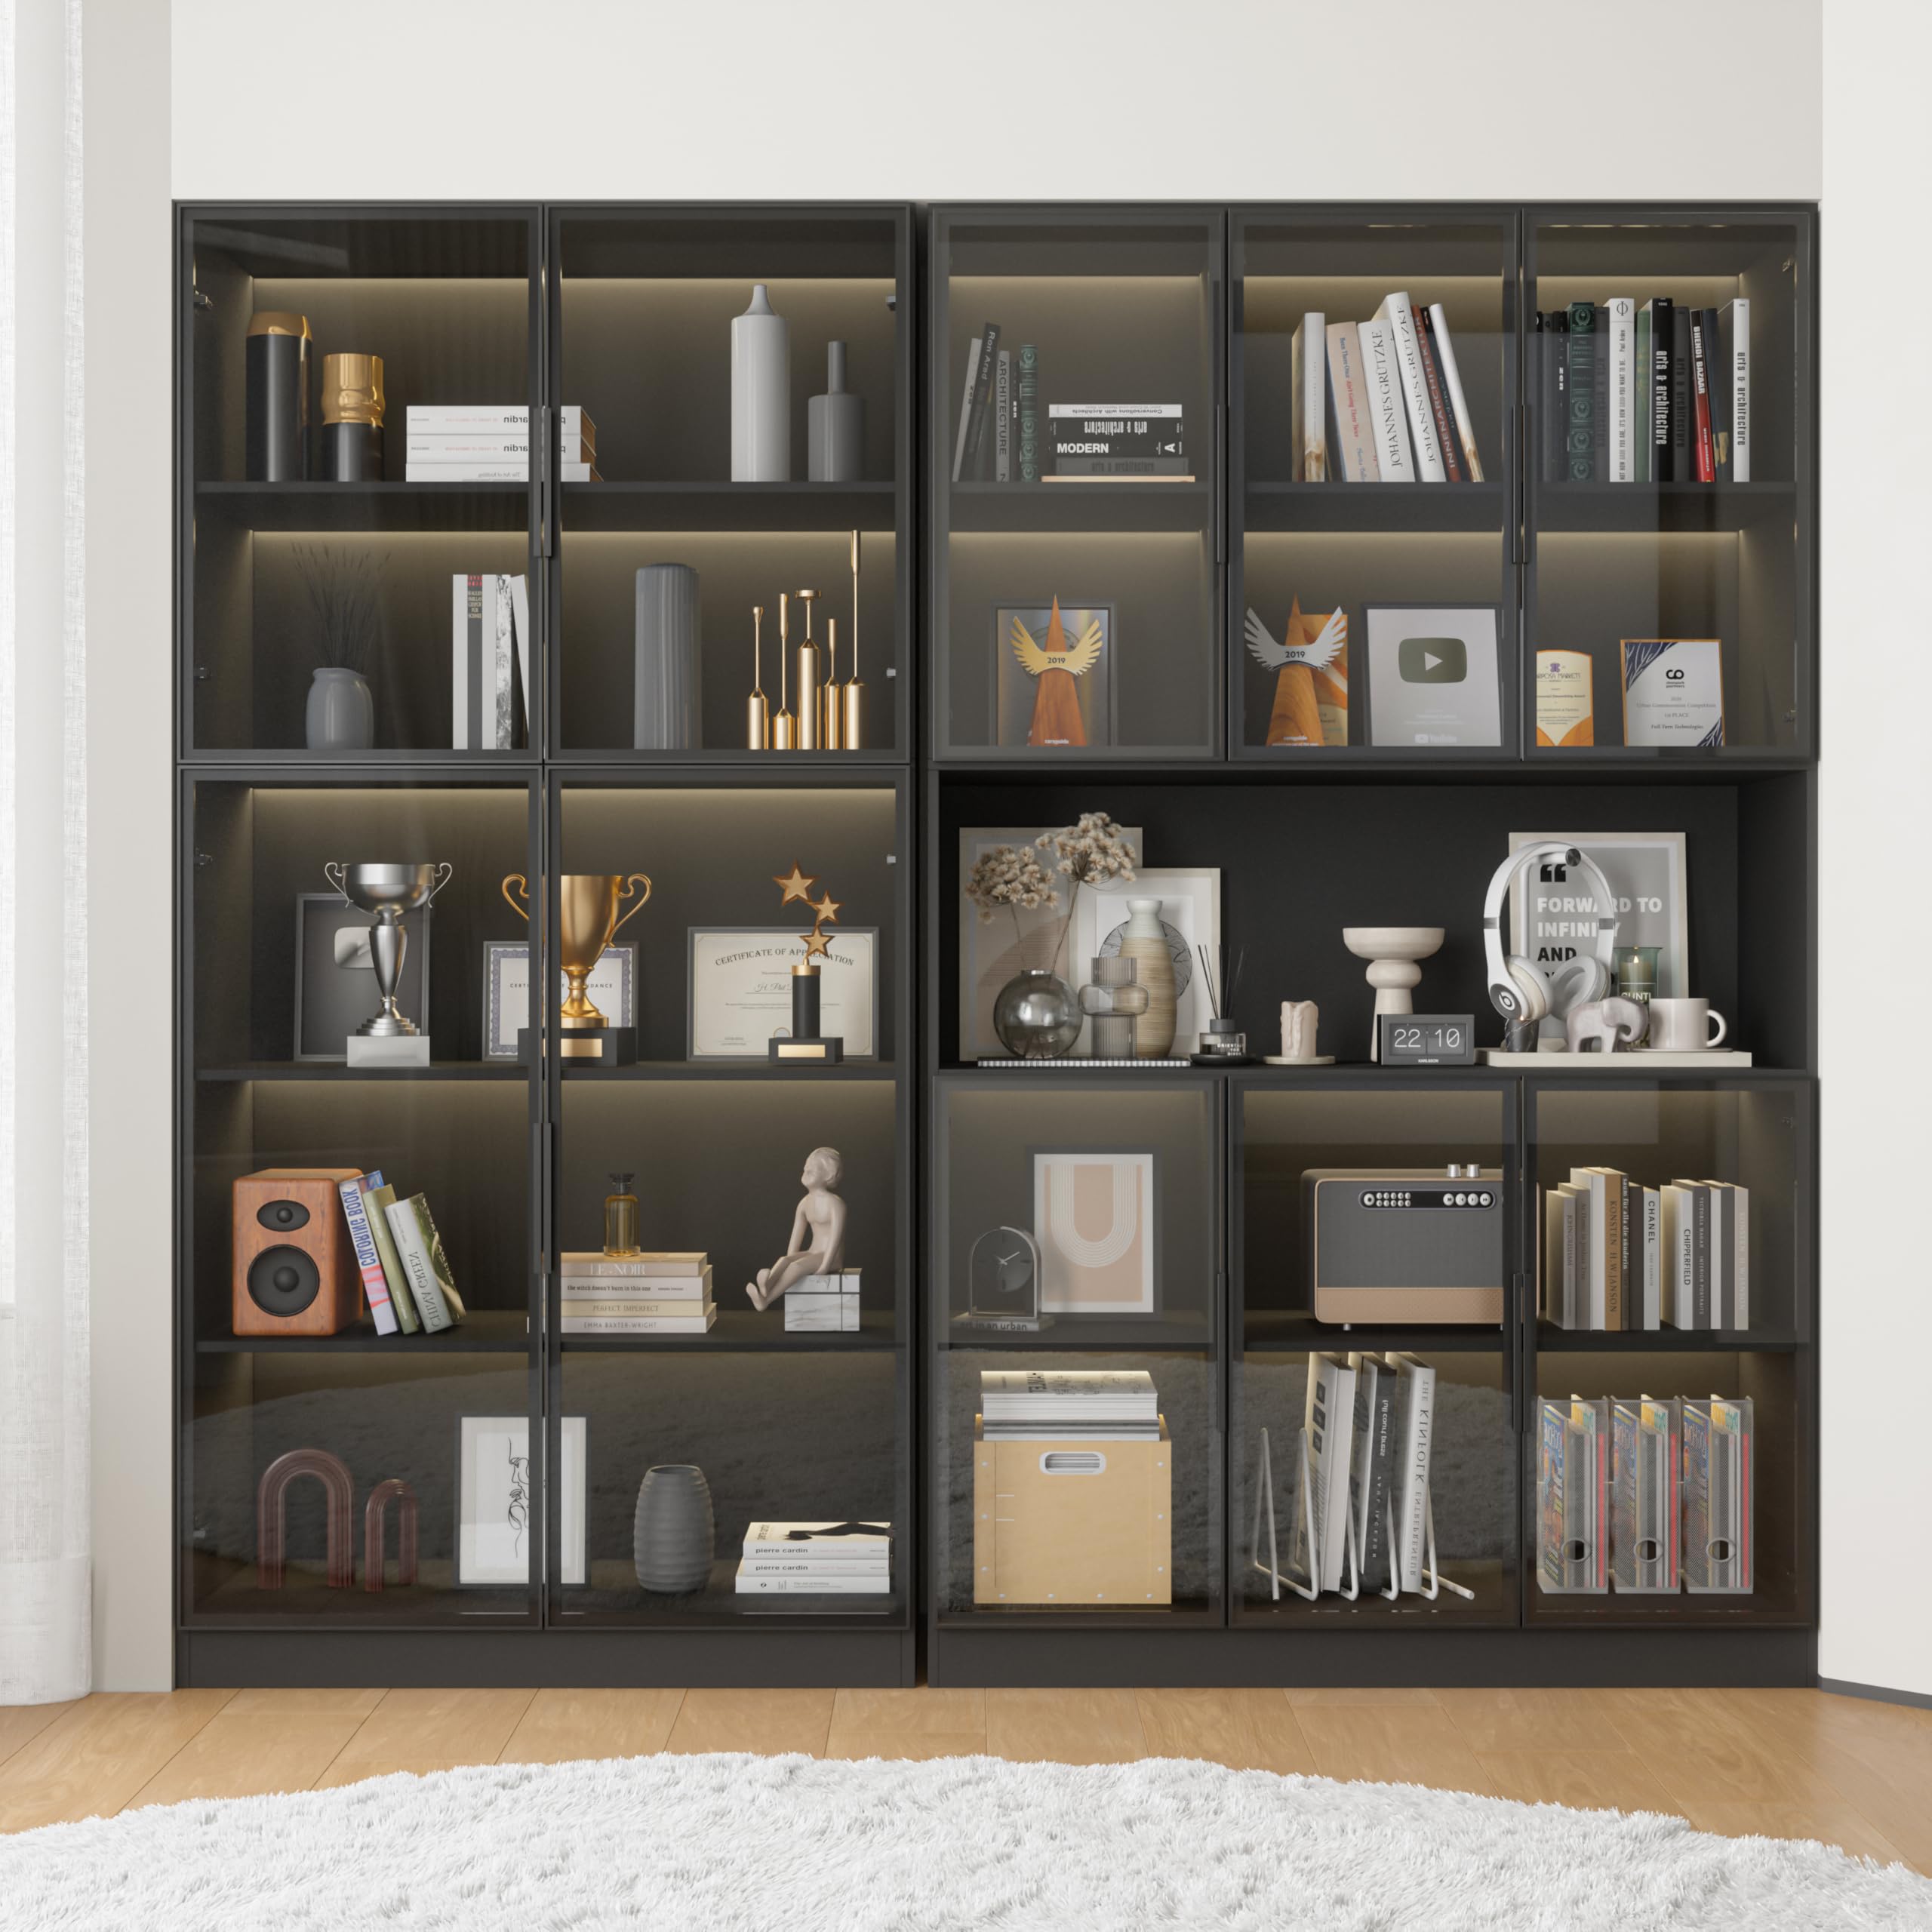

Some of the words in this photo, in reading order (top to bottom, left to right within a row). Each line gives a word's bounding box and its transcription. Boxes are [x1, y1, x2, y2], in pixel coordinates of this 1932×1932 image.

[988, 331, 996, 352] Ron
[1693, 325, 1702, 358] BHENDI
[981, 355, 991, 380] Arad
[1656, 351, 1667, 370] arts
[1737, 352, 1746, 371] arts
[1696, 361, 1706, 395] BAZAAR
[998, 359, 1007, 456] ARCHITECTURE
[1655, 386, 1669, 445] architecture
[1737, 386, 1746, 445] architecture
[1084, 421, 1124, 436] architecture
[1134, 421, 1147, 435] arts
[1413, 381, 1436, 463] JOHANNES
[1383, 396, 1403, 468] JOHANNES
[1057, 443, 1109, 453] MODERN
[1284, 650, 1306, 658] 2019
[1636, 897, 1663, 912] TO
[1537, 922, 1620, 937] INFINIY
[715, 949, 773, 966] CERTIFICATE
[1537, 947, 1577, 961] AND
[1394, 1029, 1421, 1048] 22
[1435, 1028, 1460, 1048] 10
[1609, 1201, 1617, 1246] KONSTEN
[590, 1263, 605, 1275] LE
[614, 1263, 647, 1275] NOIR
[1001, 1321, 1027, 1331] urban
